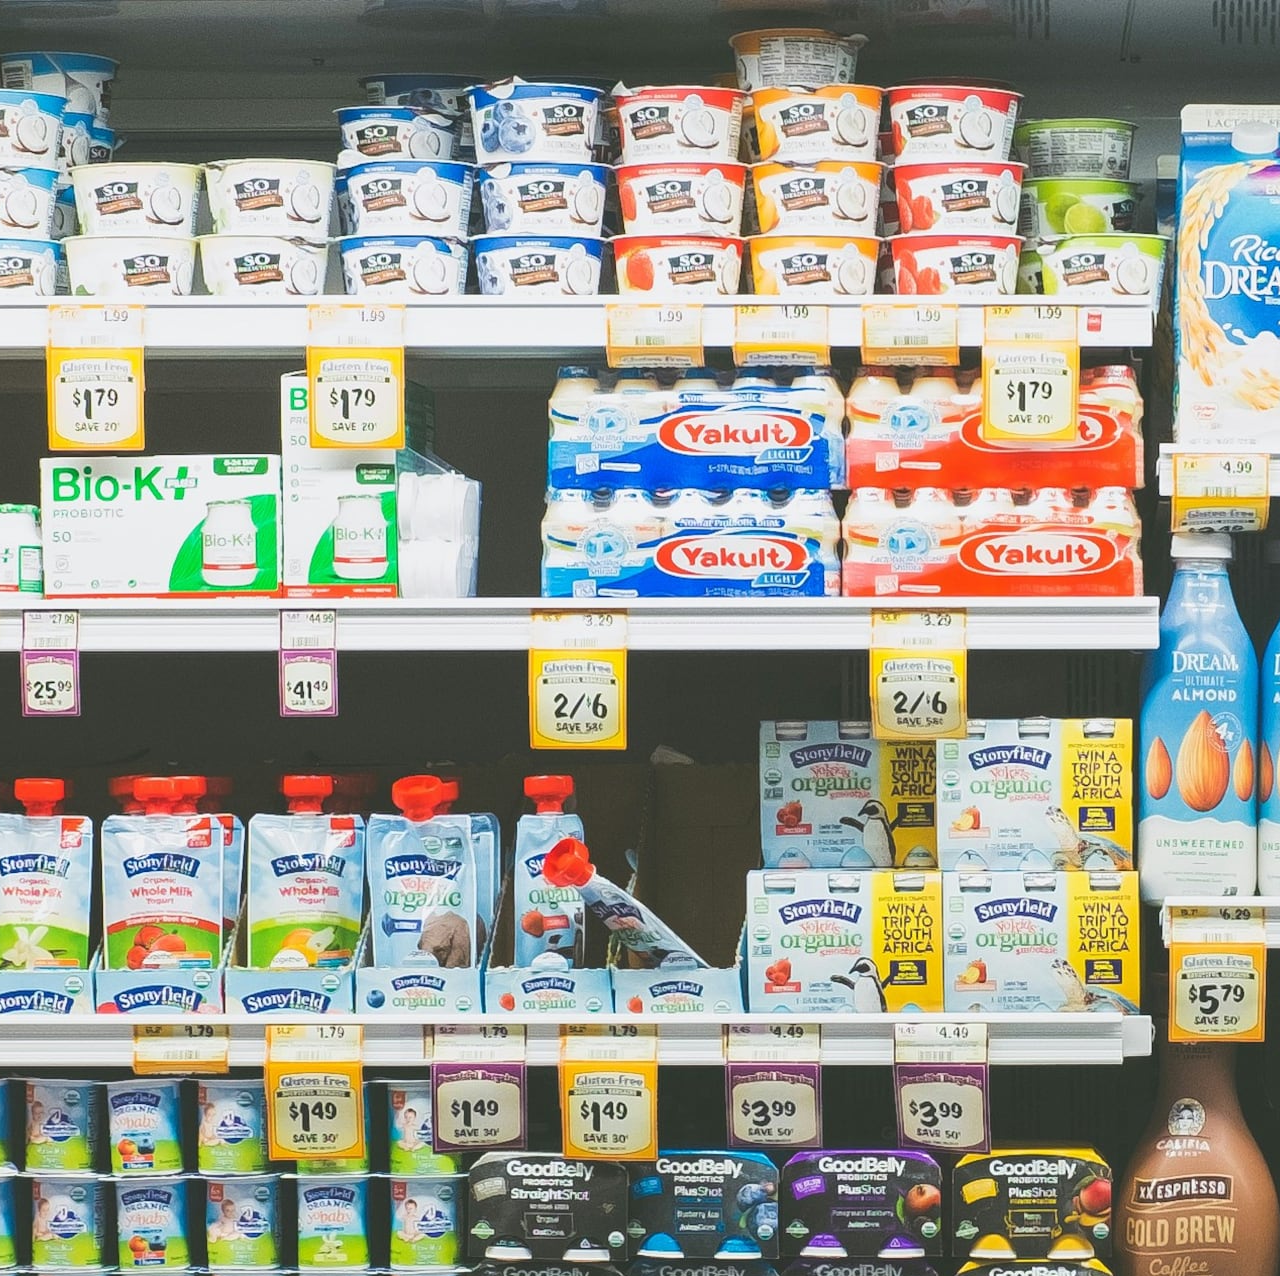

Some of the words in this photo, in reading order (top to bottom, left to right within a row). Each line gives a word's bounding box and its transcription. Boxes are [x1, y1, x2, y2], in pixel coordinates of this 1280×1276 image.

[684, 424, 790, 445] Yakult
[1185, 676, 1225, 687] ULTIMATE
[1172, 689, 1238, 702] ALMOND
[1156, 838, 1244, 850] UNSWEETENED
[784, 901, 857, 922] Stonyfield
[887, 904, 914, 916] WIN
[918, 904, 928, 916] A
[883, 916, 911, 928] TRIP
[915, 916, 931, 928] TO
[884, 929, 931, 941] SOUTH
[780, 931, 864, 954] organic
[884, 942, 933, 954] AFRICA
[656, 1158, 743, 1179] GoodBelly
[988, 1159, 1077, 1180] GoodBelly
